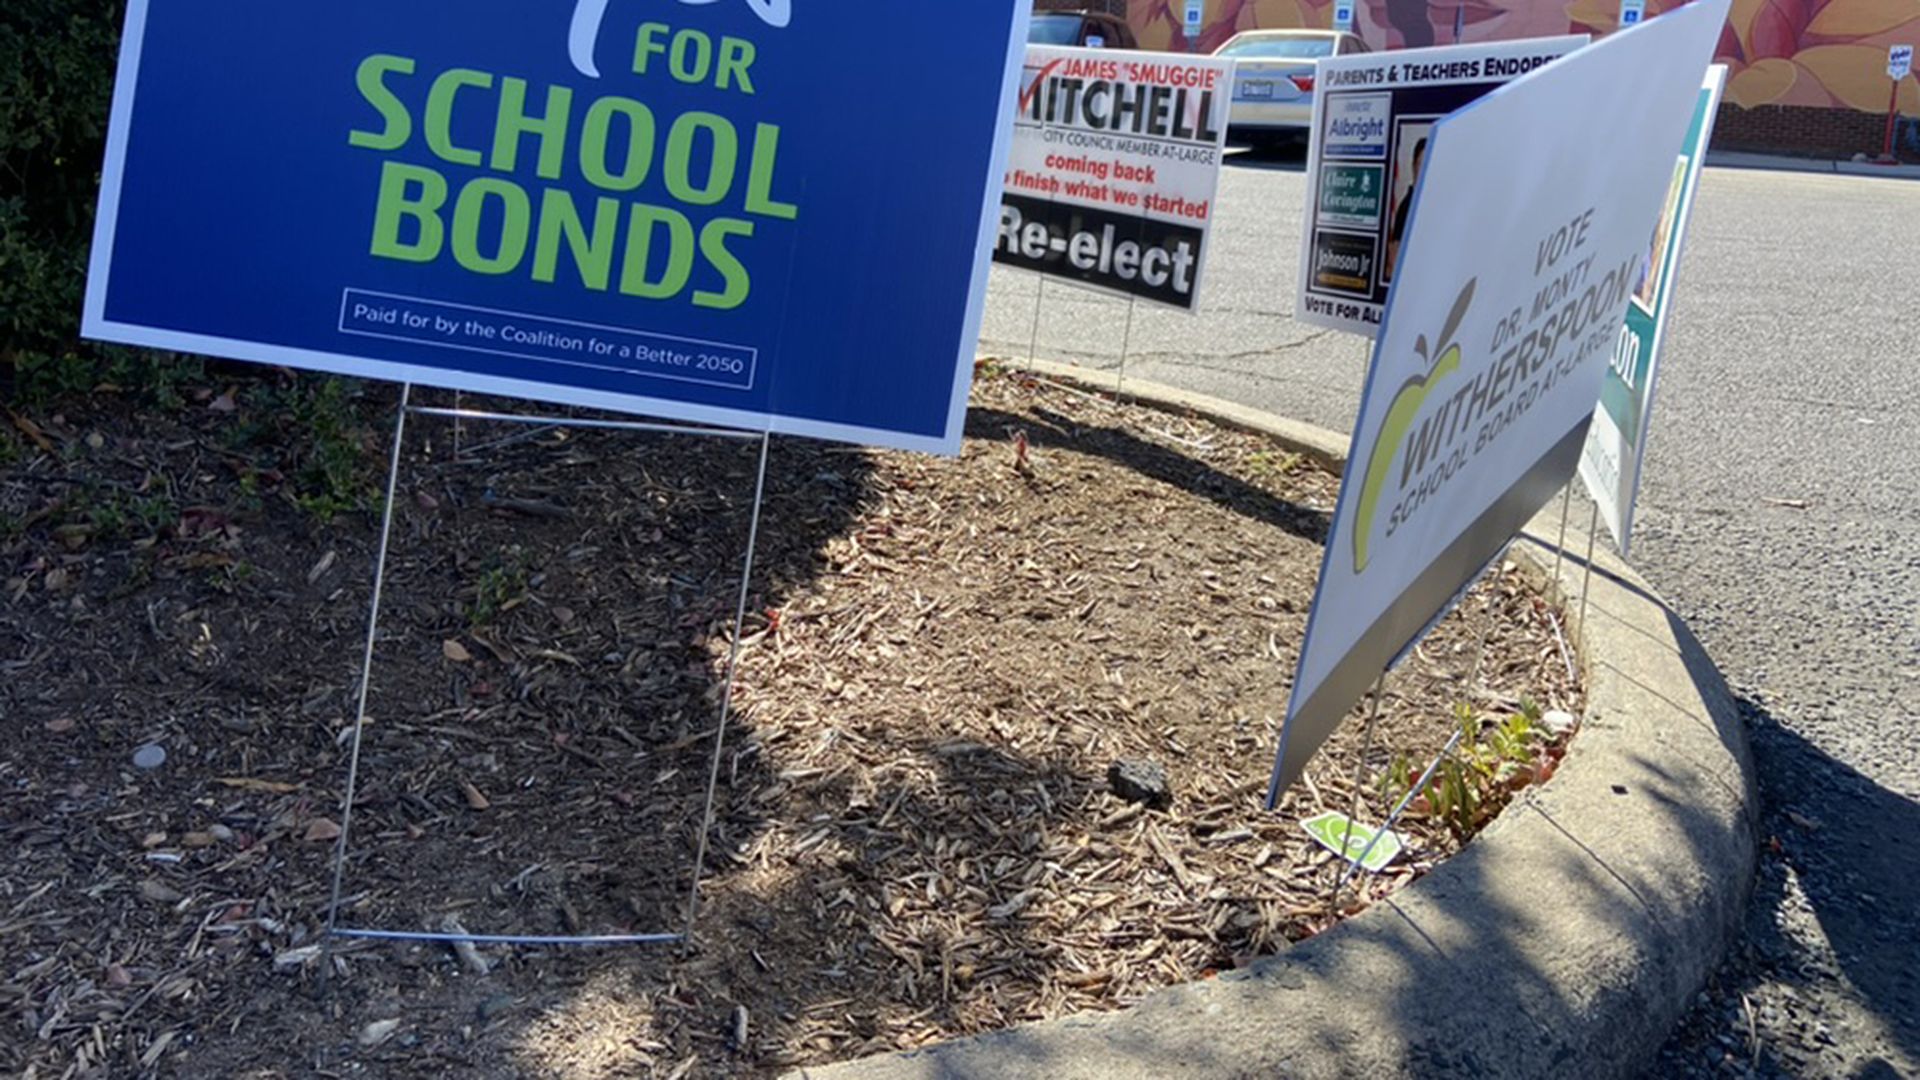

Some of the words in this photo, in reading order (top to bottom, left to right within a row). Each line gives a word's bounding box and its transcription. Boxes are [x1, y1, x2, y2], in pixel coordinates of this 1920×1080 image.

[632, 22, 756, 93] FOR
[1063, 57, 1117, 79] JAMES
[1124, 63, 1223, 88] "SMUGGIE"
[1326, 66, 1384, 86] PARENTS
[1388, 64, 1398, 82] &
[1402, 60, 1480, 82] TEACHERS
[348, 53, 797, 219] SCHOOL
[1043, 129, 1065, 144] CITY
[1067, 132, 1113, 151] COUNCIL
[1117, 140, 1161, 157] MEMBER
[1161, 146, 1216, 165] AT-LARGE
[1329, 117, 1383, 141] Albright
[1014, 169, 1060, 192] finish
[1065, 180, 1109, 202] what
[1113, 189, 1138, 207] we
[1144, 193, 1209, 219] started
[1045, 154, 1108, 180] coming
[1113, 161, 1156, 184] back
[370, 161, 754, 309] BONDS
[993, 204, 1193, 293] Re-elect
[1317, 248, 1359, 271] Johnson
[1359, 253, 1371, 276] Jr
[1534, 207, 1595, 277] VOTE
[354, 303, 397, 324] Paid
[403, 310, 430, 328] for
[435, 316, 459, 335] by
[465, 321, 495, 339] the
[501, 325, 583, 350] Coalition
[588, 338, 614, 354] for
[619, 345, 630, 358] a
[636, 345, 692, 366] Better
[696, 354, 744, 373] 2050
[1305, 296, 1334, 316] VOTE
[1336, 303, 1359, 320] FOR
[1490, 306, 1522, 355] DR.
[1529, 252, 1596, 324] MONTY
[1399, 253, 1638, 491] WITHERSPOON
[1386, 442, 1469, 538] SCHOOL
[1474, 379, 1538, 456] BOARD
[1540, 315, 1617, 398] AT-LARGE
